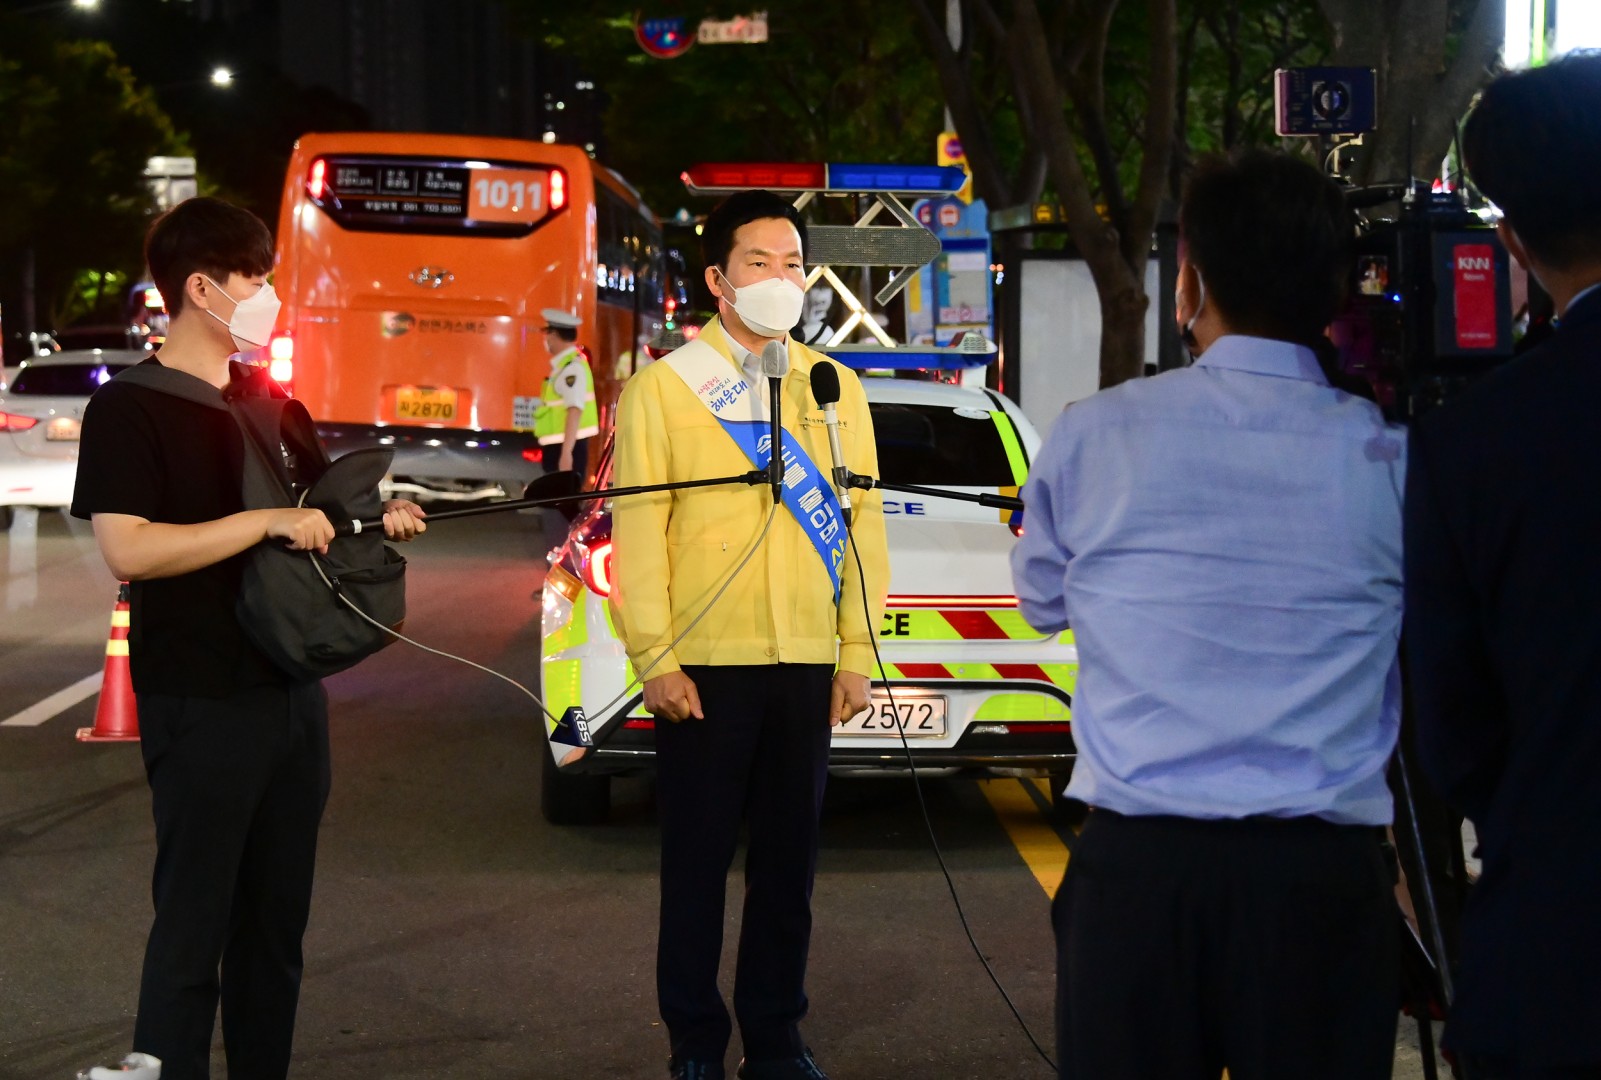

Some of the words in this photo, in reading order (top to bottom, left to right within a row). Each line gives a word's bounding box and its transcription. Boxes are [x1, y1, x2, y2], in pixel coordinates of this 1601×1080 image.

[475, 179, 541, 210] 1011
[1458, 257, 1490, 270] KNN
[411, 402, 453, 418] 2870
[710, 380, 749, 412] 해운대
[797, 486, 840, 545] 줄이면
[573, 710, 592, 743] KBS
[861, 703, 934, 730] 2572
